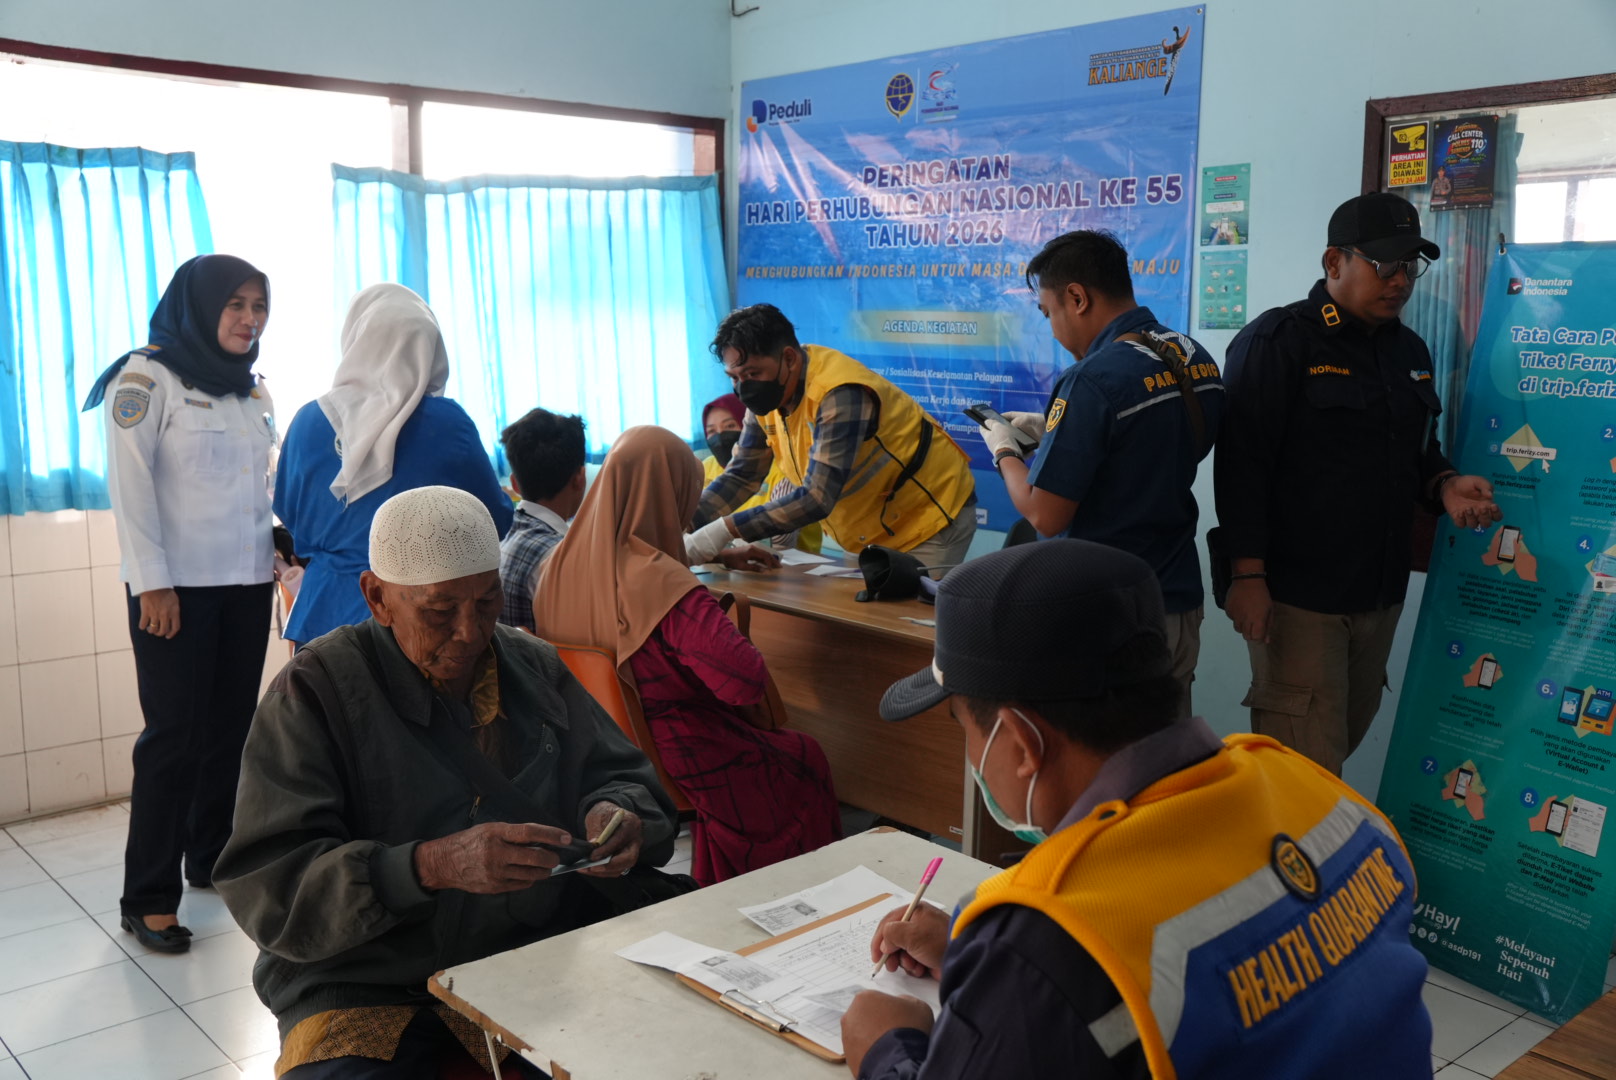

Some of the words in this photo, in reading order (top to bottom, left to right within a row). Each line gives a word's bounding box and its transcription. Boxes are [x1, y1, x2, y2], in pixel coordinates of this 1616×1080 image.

[769, 98, 812, 120] Peduli
[1448, 132, 1460, 142] CALL
[1461, 130, 1483, 138] CENTER
[1471, 138, 1484, 149] 110
[1392, 152, 1426, 162] PERHATIAN
[862, 153, 1011, 189] PERINGATAN
[1393, 162, 1412, 170] AREA
[1414, 160, 1424, 168] INI
[1393, 168, 1423, 178] DIAWASI
[746, 202, 791, 225] HARI
[794, 189, 957, 224] PERHUBUNGAN
[959, 181, 1090, 214] NASIONAL
[1098, 177, 1138, 206] KE
[1146, 175, 1184, 204] 55
[865, 222, 940, 250] TAHUN
[944, 219, 1004, 247] 2026
[746, 266, 844, 281] MENGHUBUNGKAN
[847, 264, 917, 280] INDONESIA
[922, 263, 967, 278] UNTUK
[971, 262, 1014, 278] MASA
[1133, 258, 1182, 276] MAJU
[1524, 278, 1573, 287] Danantara
[1523, 287, 1568, 296] Indonesia
[882, 319, 926, 334] AGENDA
[926, 320, 979, 337] KEGIATAN
[1511, 326, 1550, 344] Tata
[1554, 327, 1598, 346] Cara
[1520, 351, 1566, 370] Tiket
[1568, 354, 1616, 375] Ferry
[890, 367, 926, 378] Sosialisasi
[927, 368, 973, 382] Keselamatan
[974, 372, 1014, 385] Pelayaran
[1144, 364, 1218, 392] PAREDIC
[1518, 376, 1538, 393] di
[1540, 378, 1616, 399] trip.feriz
[930, 394, 950, 406] Kerja
[951, 396, 966, 406] dan
[944, 422, 980, 434] Penumpan
[1490, 418, 1498, 429] 1.
[1604, 428, 1614, 438] 2.
[1506, 446, 1550, 458] trip.ferizy.com
[1494, 480, 1536, 490] trip.ferizy.com
[1518, 474, 1541, 483] Website
[1580, 484, 1608, 493] password
[1579, 540, 1590, 550] 4.
[1488, 614, 1521, 626] penumpang
[1451, 644, 1461, 655] 5.
[1541, 684, 1554, 696] 6.
[1597, 688, 1611, 698] ATM
[1530, 728, 1544, 737] Pilih
[1545, 732, 1560, 742] jenis
[1562, 737, 1587, 750] metode
[1588, 744, 1616, 759] pembaya
[1544, 740, 1559, 750] yang
[1560, 745, 1576, 754] akan
[1576, 748, 1612, 765] digunakan
[1546, 748, 1570, 760] (Virtual
[1571, 756, 1599, 770] Account
[1600, 764, 1606, 772] &
[1426, 760, 1434, 772] 7.
[1558, 760, 1589, 776] E-Wallet)
[1524, 792, 1535, 804] 8.
[1462, 828, 1478, 838] yang
[1478, 833, 1493, 842] akan
[1470, 822, 1496, 836] pastikan
[1518, 841, 1540, 854] Setelah
[1540, 852, 1580, 870] pembayaran
[1582, 866, 1602, 878] sukses
[1516, 858, 1542, 872] diunduh
[1544, 868, 1568, 882] melalui
[1568, 877, 1596, 892] Website
[1520, 867, 1533, 877] dan
[1533, 872, 1554, 884] E-Mail
[1574, 870, 1594, 883] dapat
[1533, 881, 1569, 900] didaftarkan
[1424, 904, 1461, 936] Hay!
[1228, 923, 1324, 1029] HEALTH
[1308, 846, 1404, 967] QUARANTINE
[1442, 940, 1482, 962] @asdp191
[1495, 935, 1556, 968] #Melayani
[1496, 963, 1524, 982] Hati
[1500, 950, 1550, 980] Sepenuh
